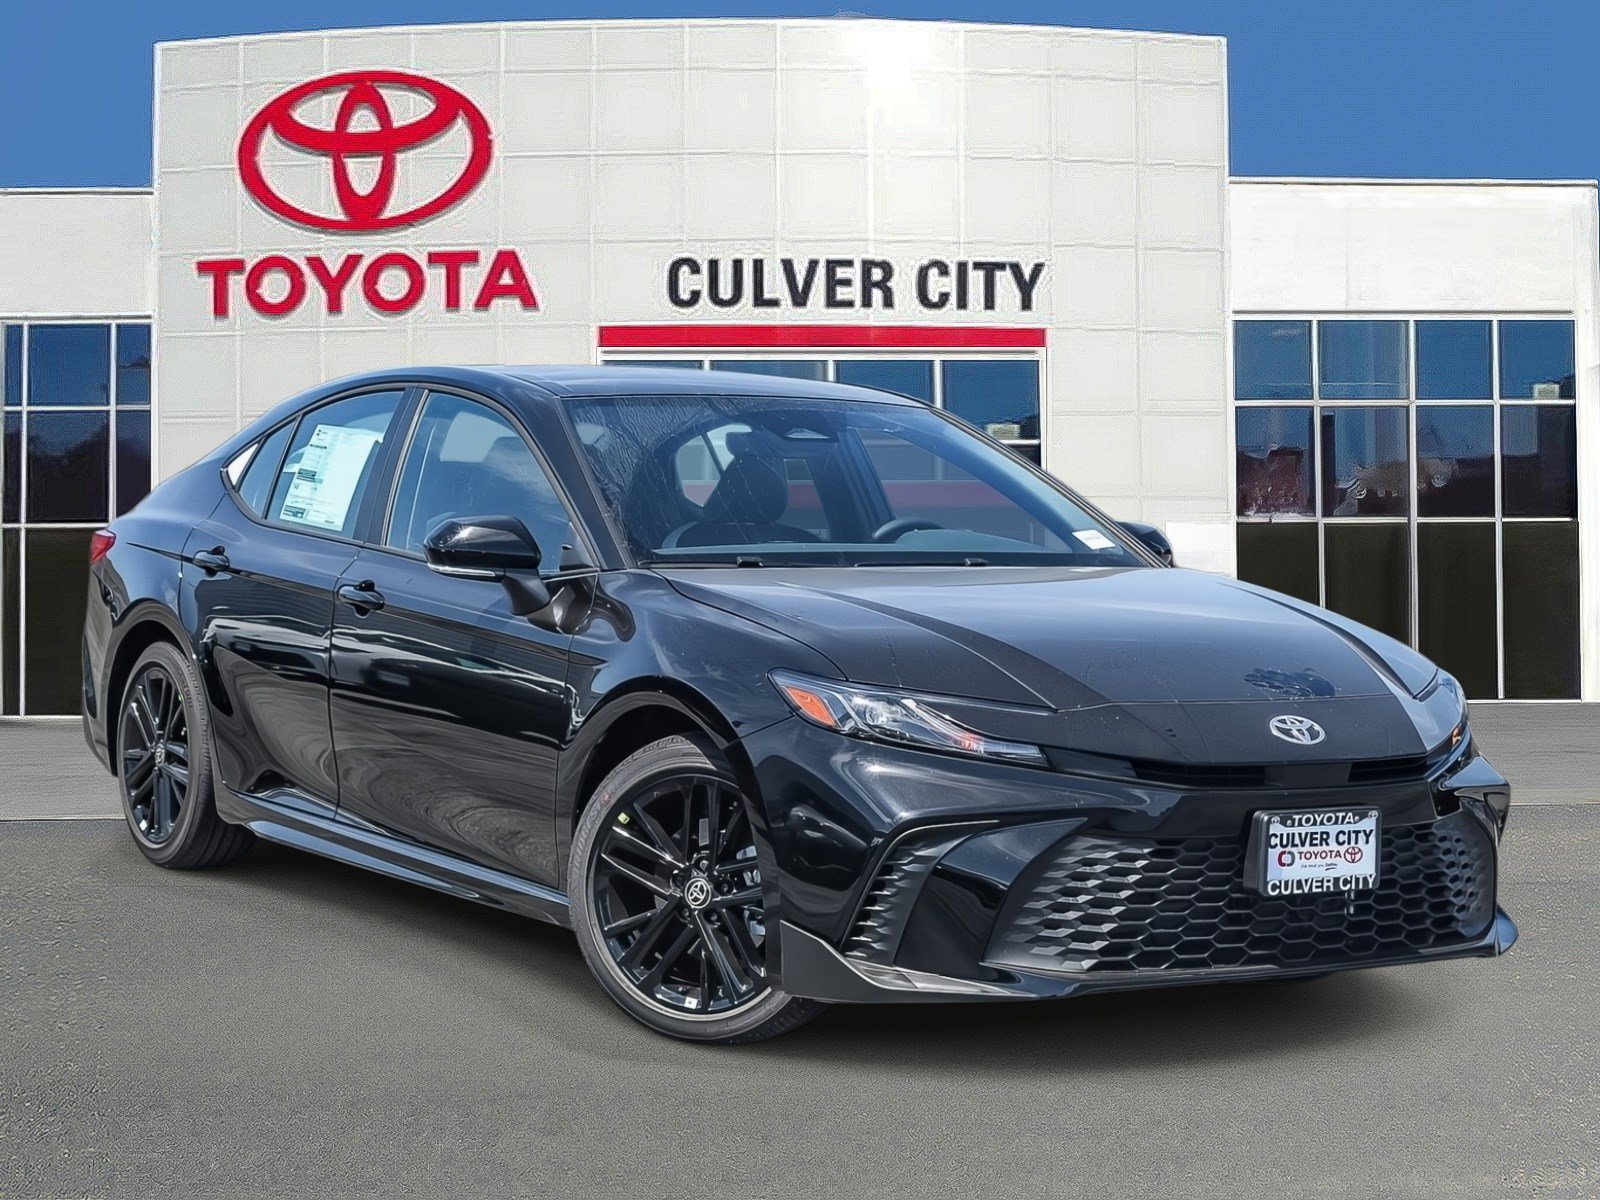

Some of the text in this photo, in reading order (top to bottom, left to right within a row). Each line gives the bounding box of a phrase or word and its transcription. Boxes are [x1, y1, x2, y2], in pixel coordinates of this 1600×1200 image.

[196, 250, 538, 318] TOYOTA
[667, 257, 1046, 312] CULVER CITY
[1292, 813, 1354, 827] TOYOTA
[1268, 829, 1373, 848] CULVER CITY
[1297, 850, 1342, 861] TOYOTA
[1267, 873, 1376, 896] CULVER CITY
